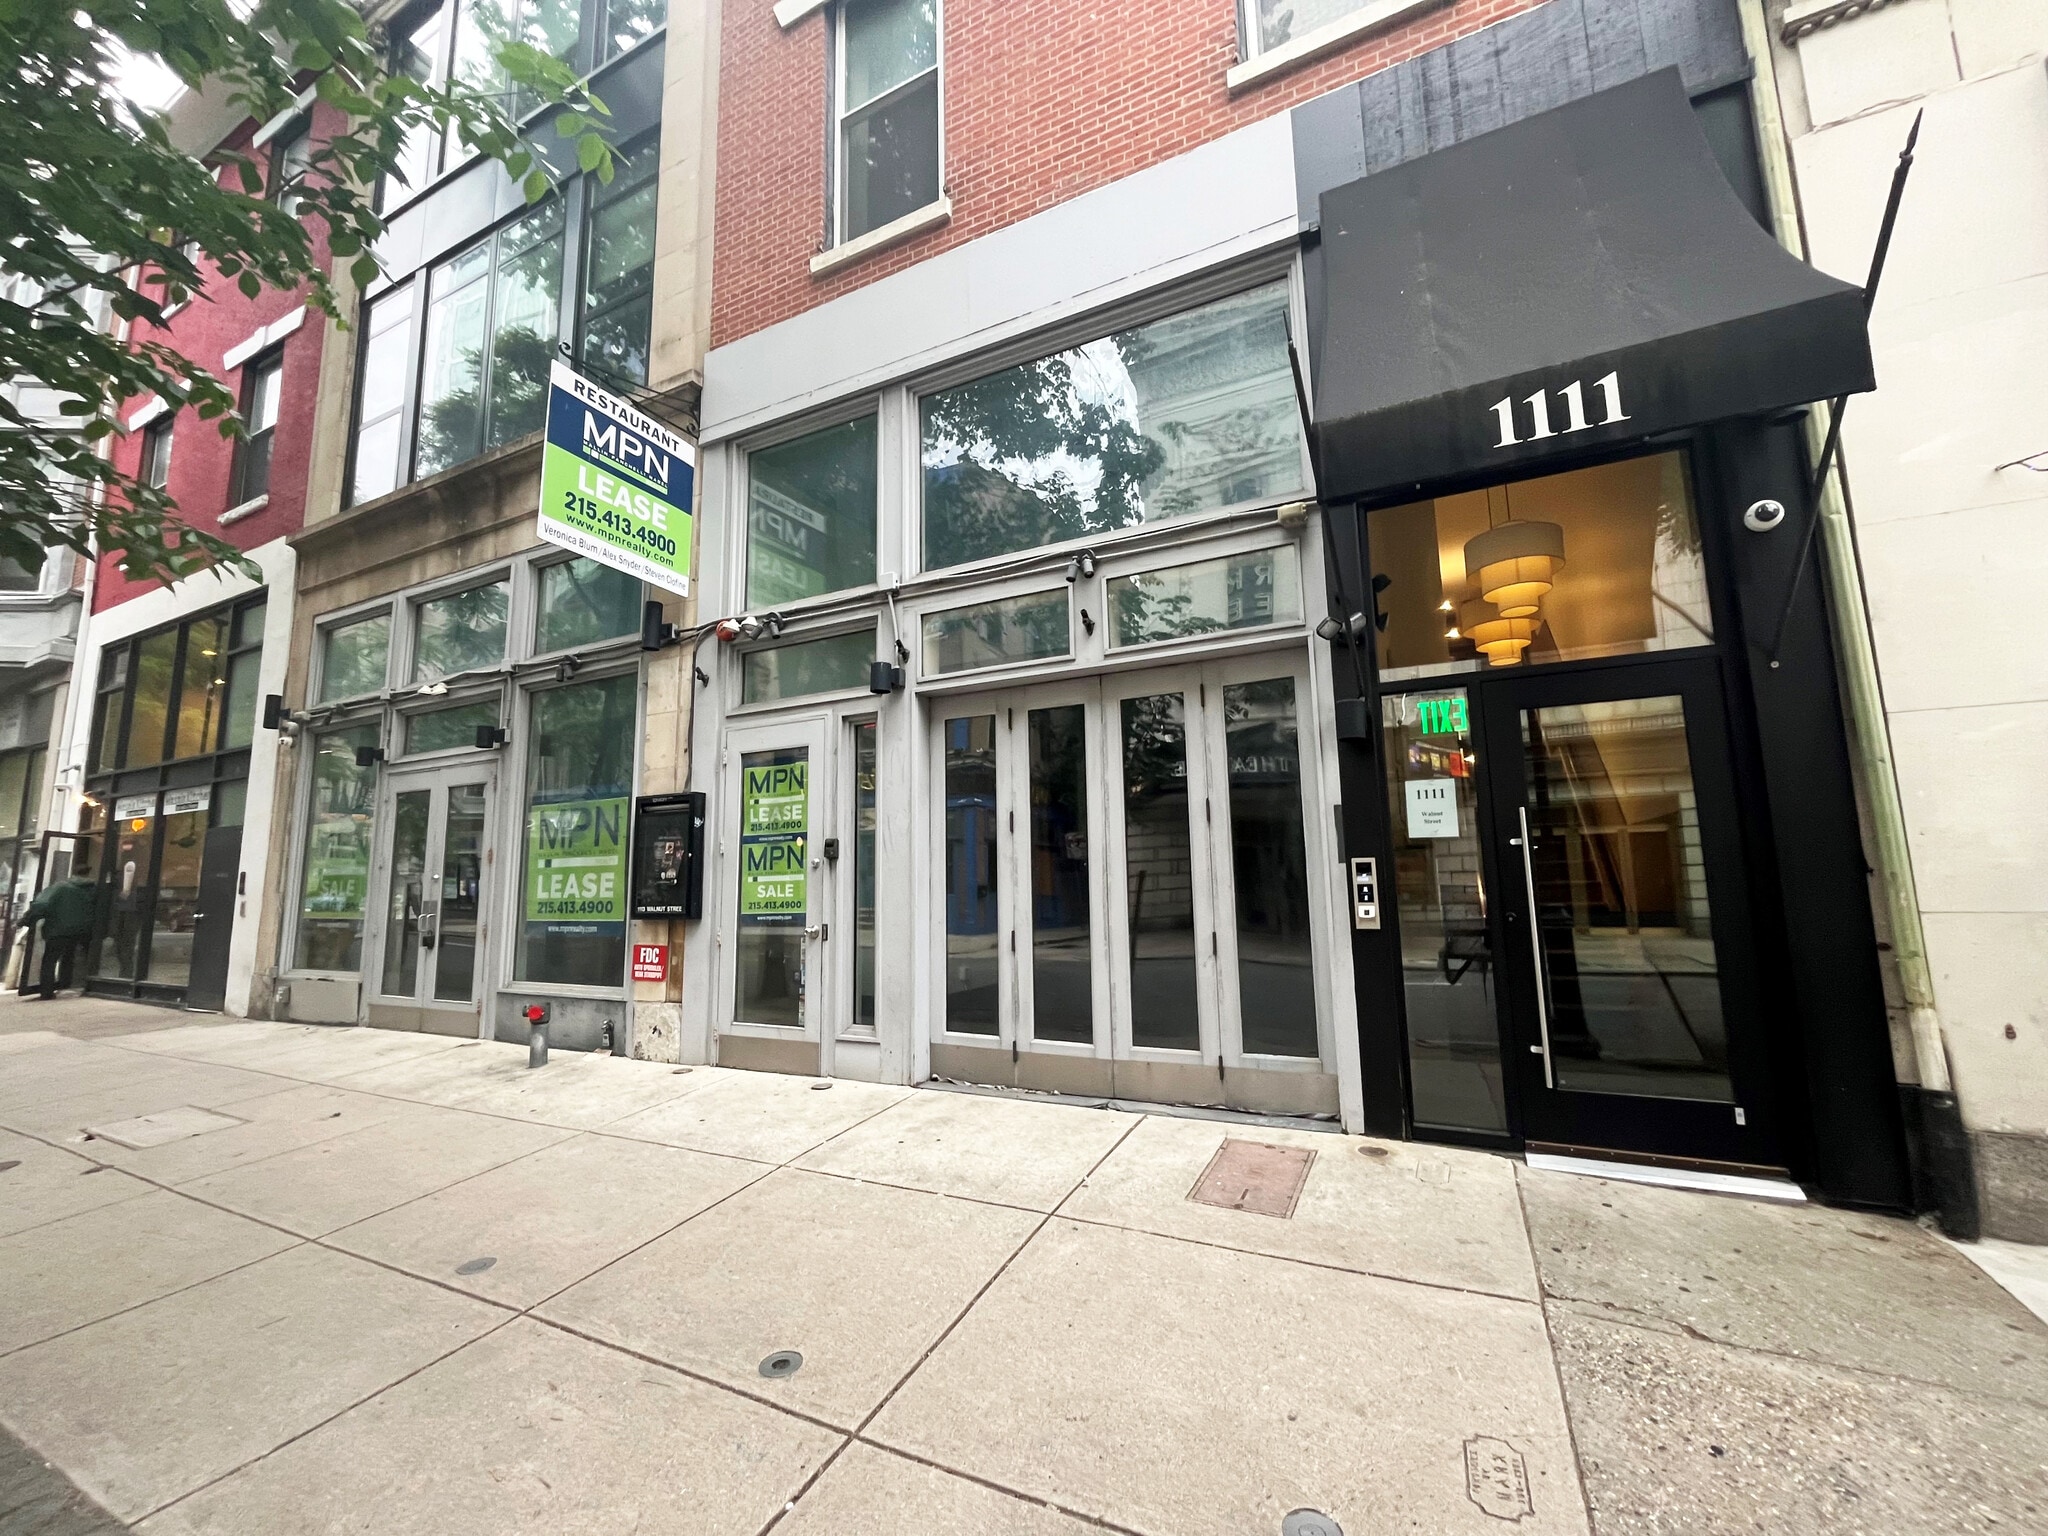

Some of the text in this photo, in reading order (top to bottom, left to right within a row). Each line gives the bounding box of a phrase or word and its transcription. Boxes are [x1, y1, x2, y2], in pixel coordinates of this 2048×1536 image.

[573, 378, 681, 453] RESTAURANT
[1489, 370, 1632, 449] 1111
[583, 409, 670, 484] MPN
[578, 464, 669, 531] LEASE
[544, 522, 577, 546] Veronica
[565, 491, 676, 557] 215.413.4900
[566, 513, 675, 568] www.mpnrealty.com
[750, 765, 806, 795] MPN
[1416, 788, 1445, 800] 1111
[539, 804, 620, 850] MPN
[750, 804, 803, 823] LEASE
[750, 820, 802, 832] 215.413.4900
[747, 844, 805, 871] MPN
[320, 879, 356, 897] SALE
[536, 872, 615, 899] LEASE
[756, 884, 795, 898] SALE
[537, 900, 614, 914] 215.413.4900
[748, 900, 802, 910] 215.413.4900
[640, 947, 660, 964] FDC
